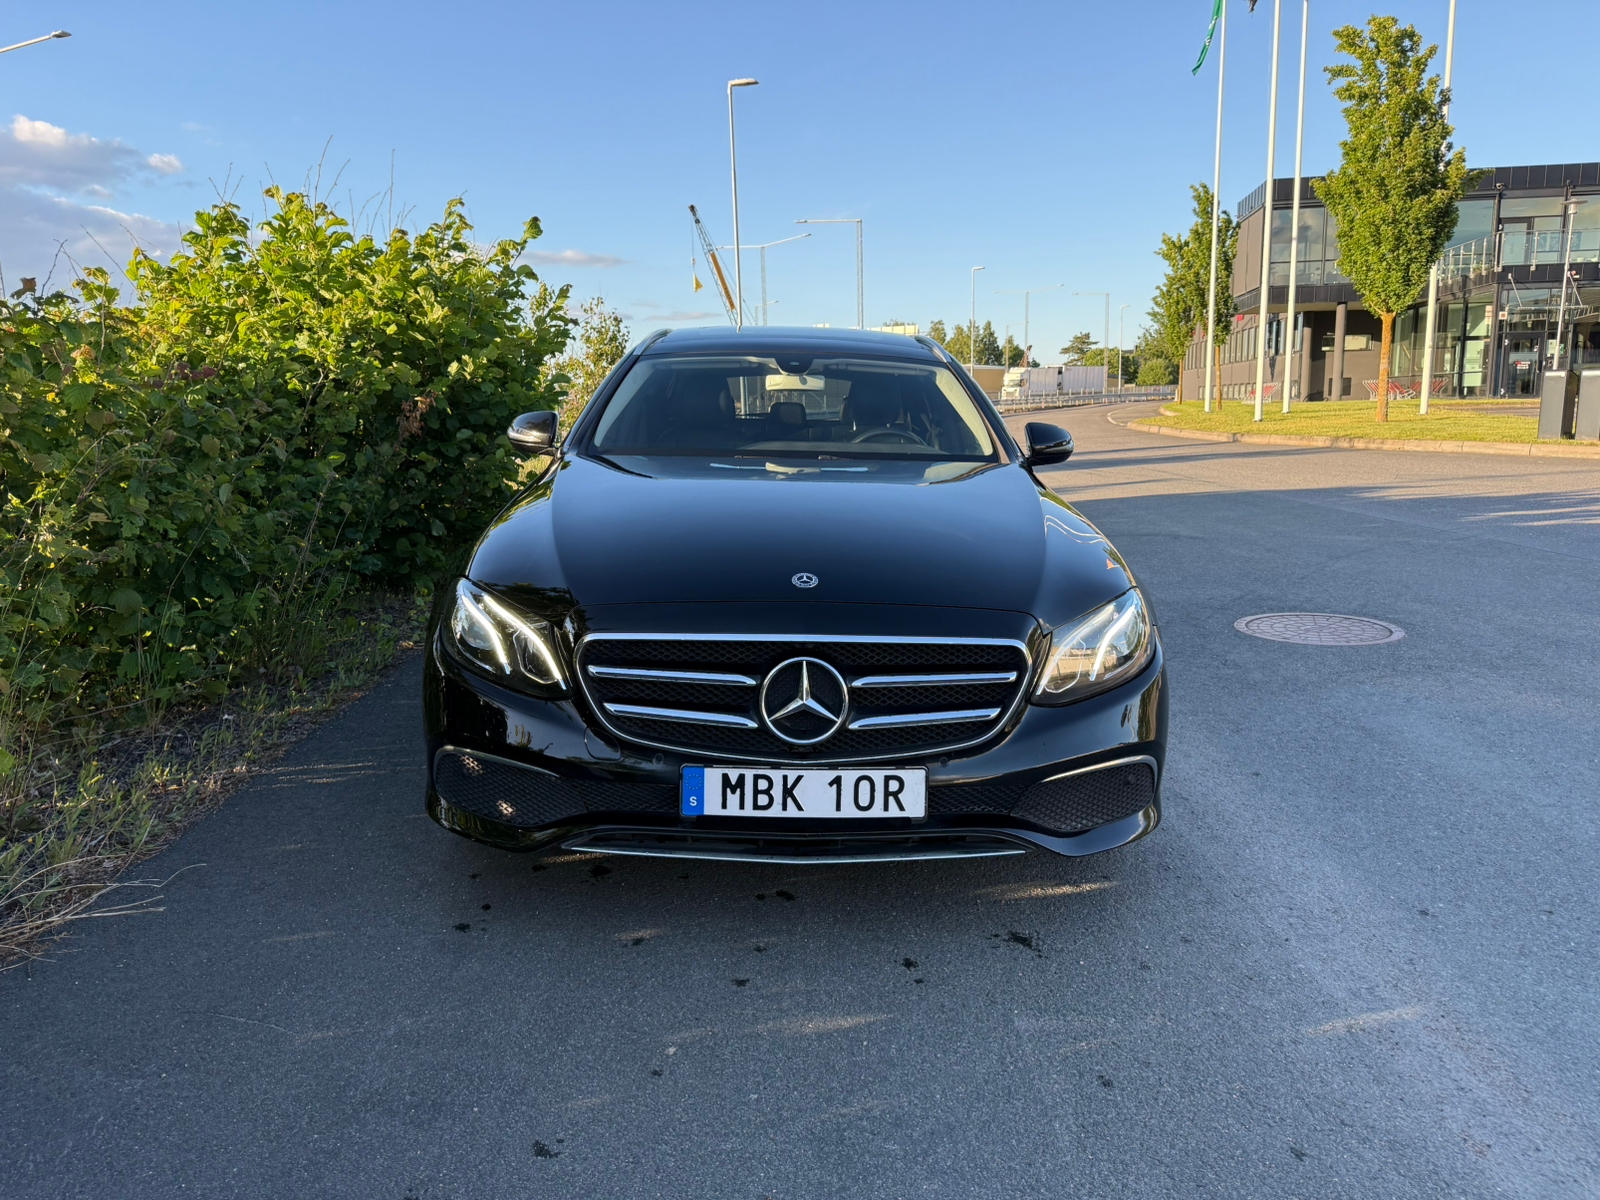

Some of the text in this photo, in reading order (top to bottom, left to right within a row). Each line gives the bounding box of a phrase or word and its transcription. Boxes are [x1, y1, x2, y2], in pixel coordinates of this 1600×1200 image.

[689, 796, 698, 807] S
[721, 773, 906, 811] MBK 10R
